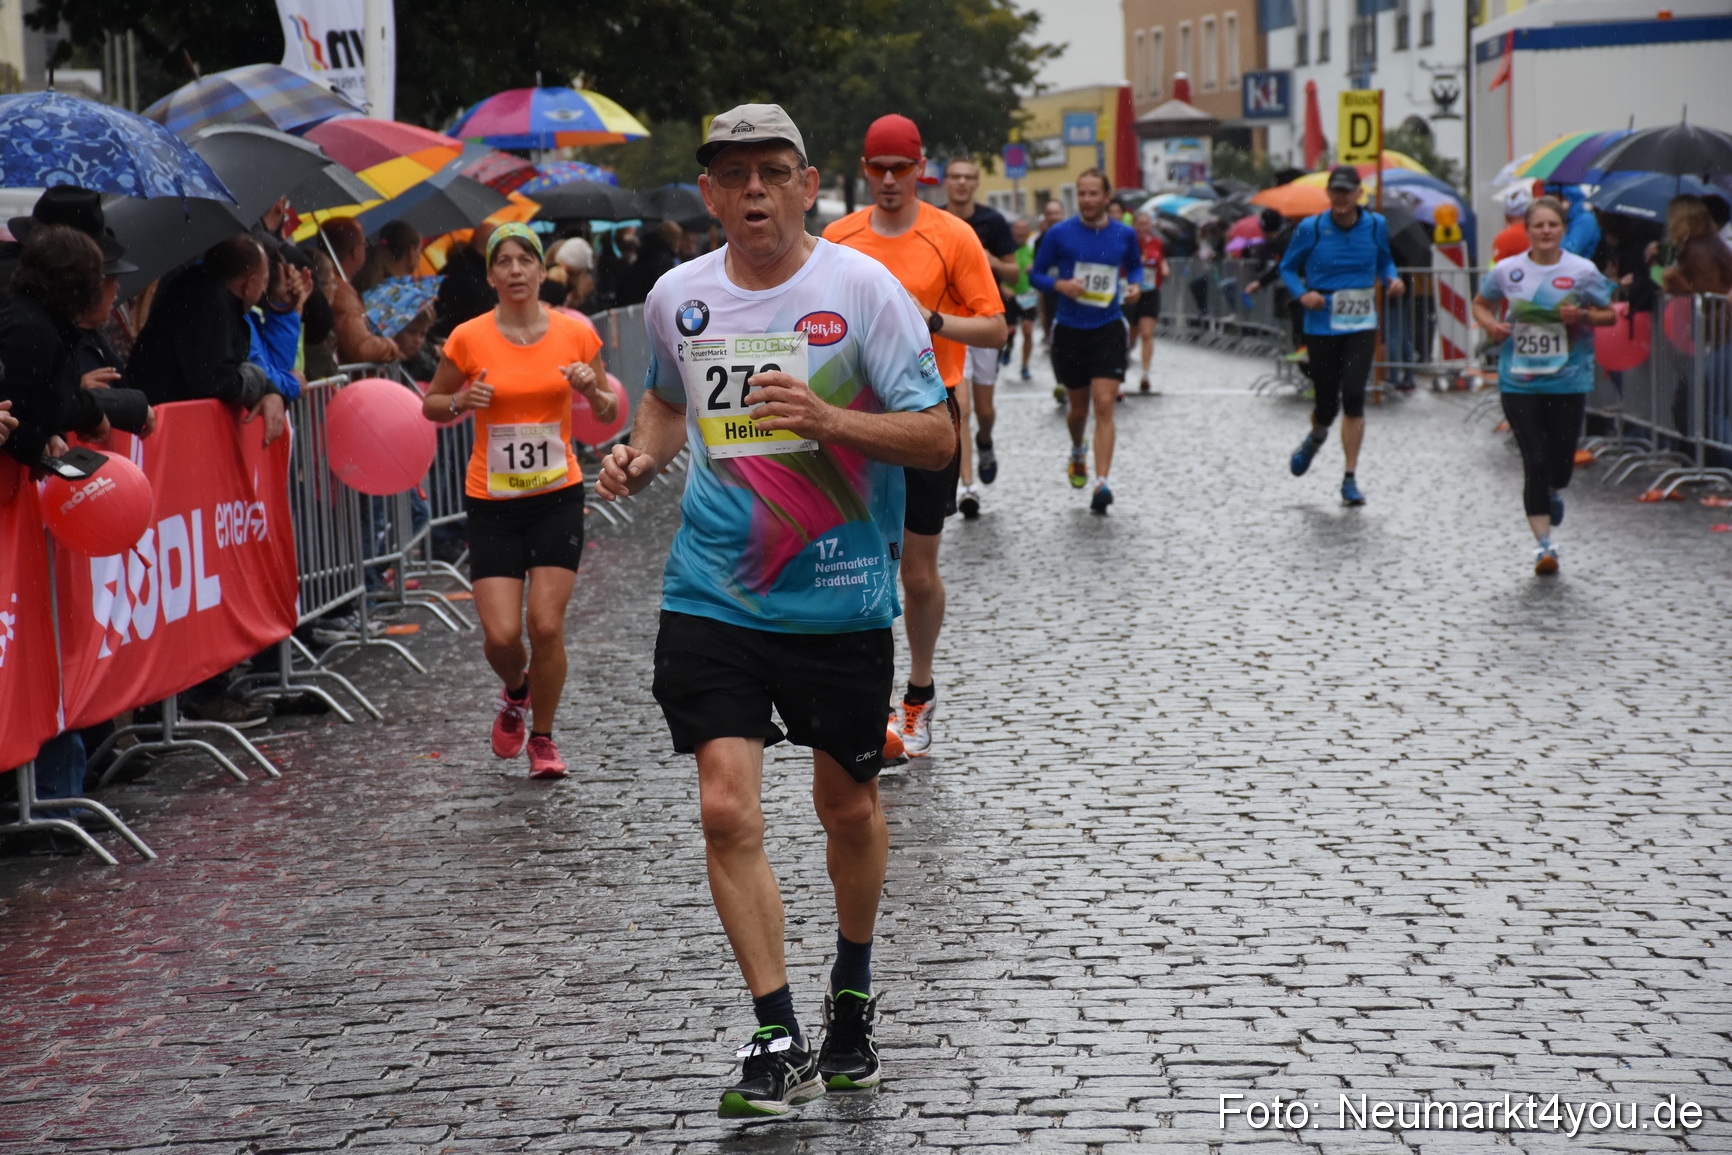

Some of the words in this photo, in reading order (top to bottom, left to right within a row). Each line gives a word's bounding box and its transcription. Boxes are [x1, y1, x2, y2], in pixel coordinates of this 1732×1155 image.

[1350, 112, 1373, 148] D
[1085, 274, 1110, 290] 196
[802, 320, 842, 337] Hervis
[734, 337, 796, 353] BOCK
[1517, 335, 1560, 354] 2591
[706, 363, 781, 411] 27
[503, 441, 548, 469] 131
[508, 475, 548, 488] Claudia
[61, 476, 113, 515] RÖDL
[815, 537, 844, 560] 17.
[815, 556, 880, 573] Neumarkter
[814, 571, 868, 588] Stadtlauf
